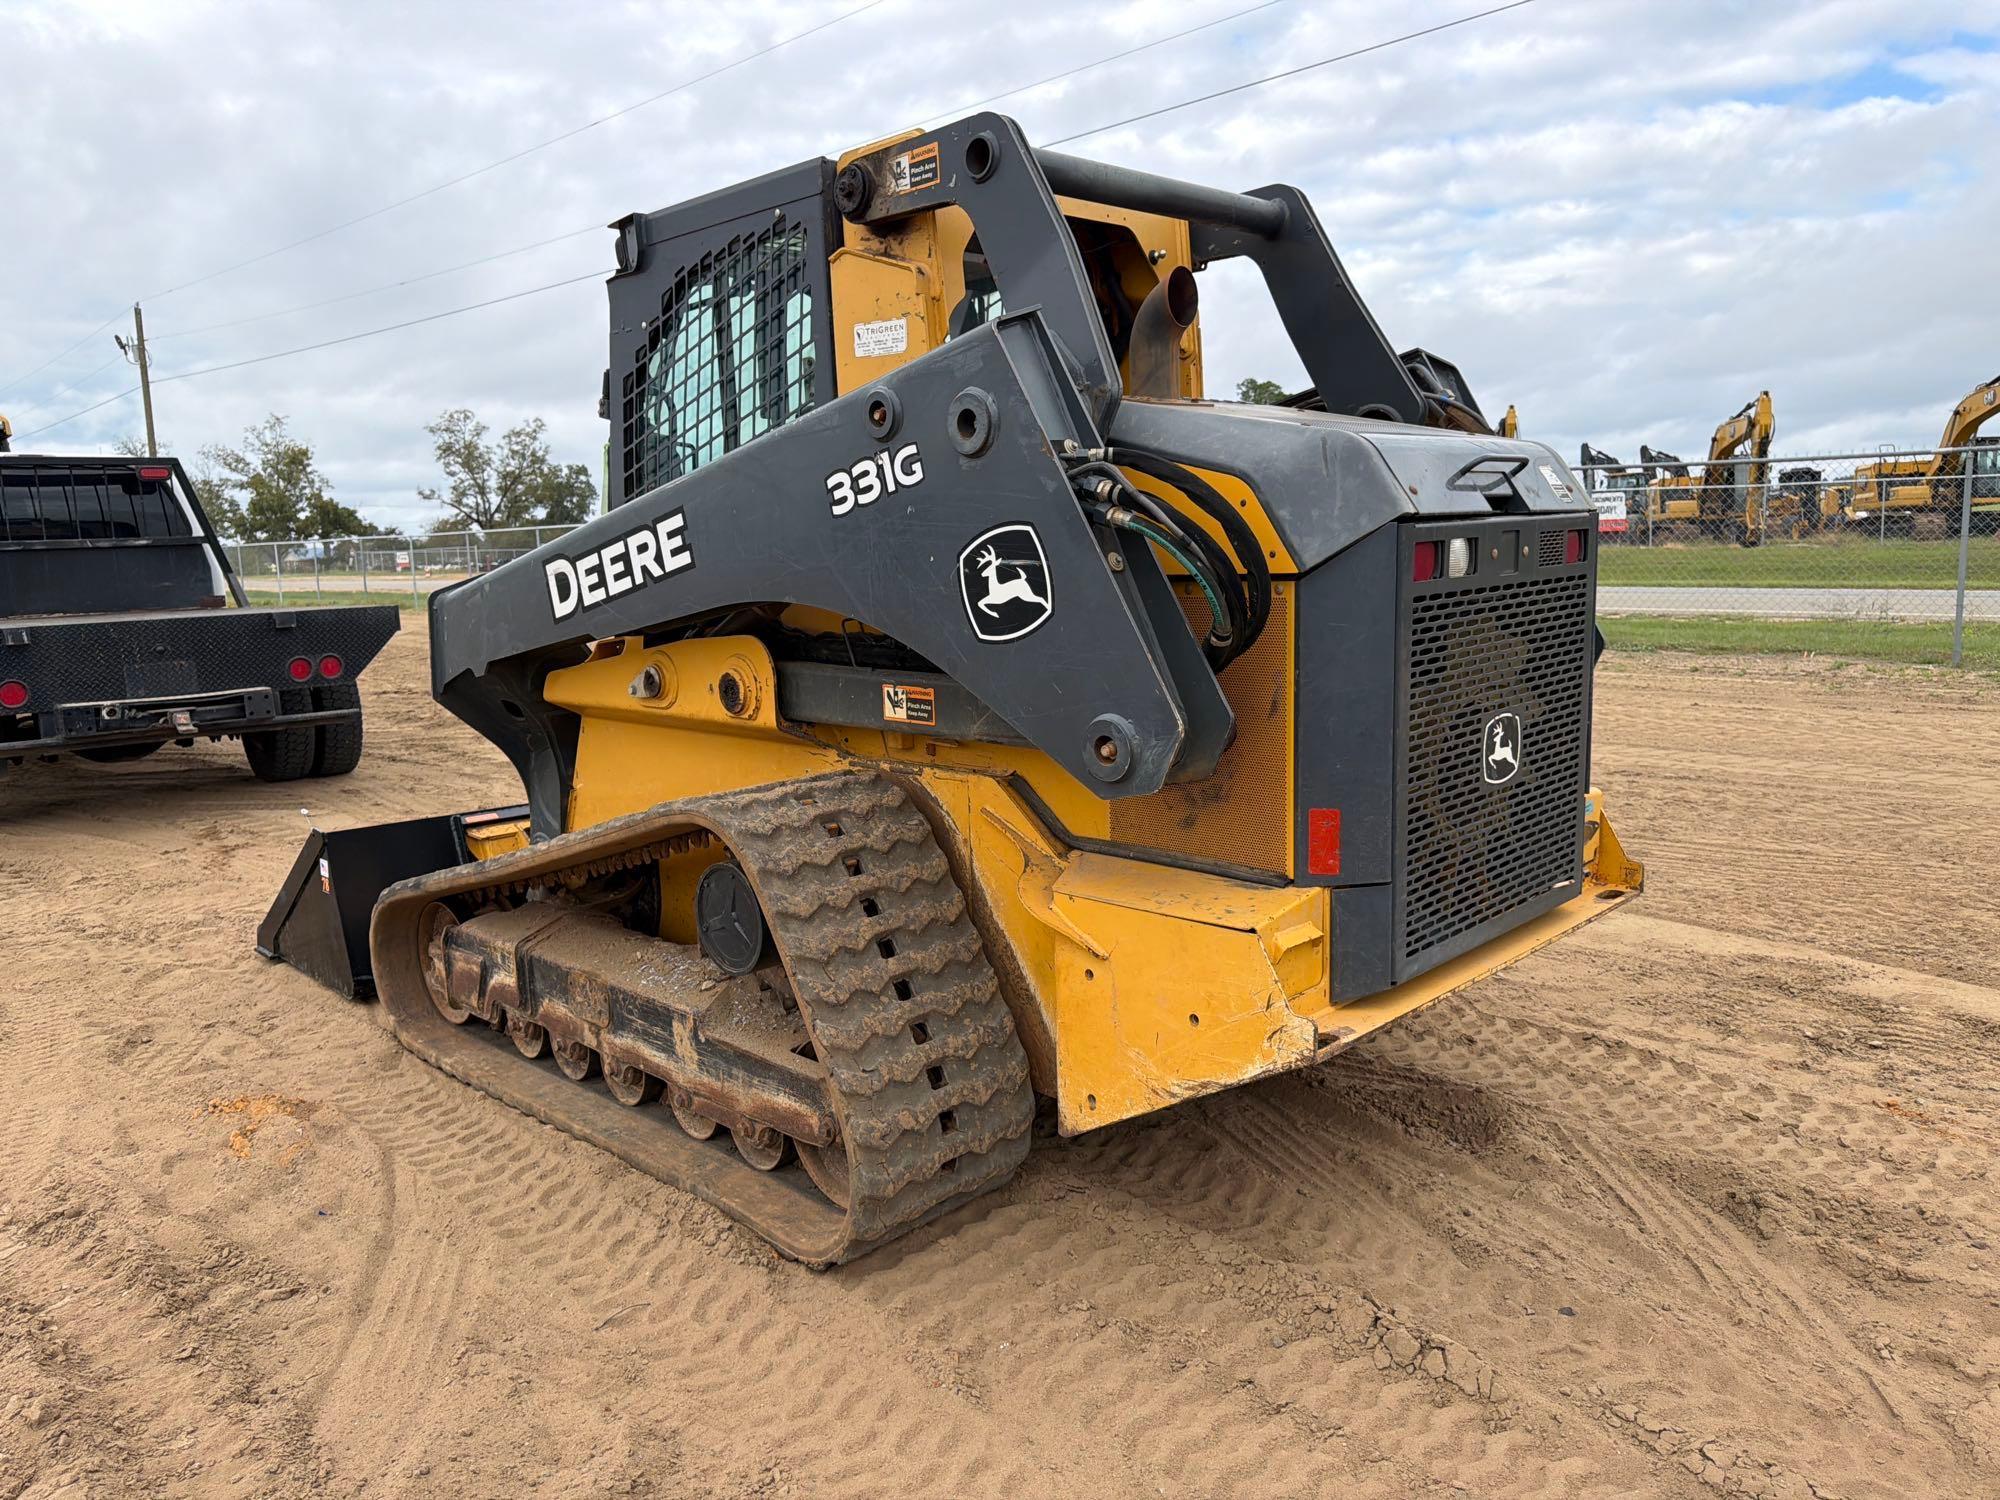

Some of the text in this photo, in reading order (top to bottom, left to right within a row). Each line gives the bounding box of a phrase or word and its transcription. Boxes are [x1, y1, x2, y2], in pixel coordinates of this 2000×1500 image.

[911, 162, 936, 175] Pinch Area
[827, 445, 924, 516] 331G
[547, 513, 692, 619] DEERE
[920, 703, 931, 711] Area
[918, 711, 929, 719] Away
